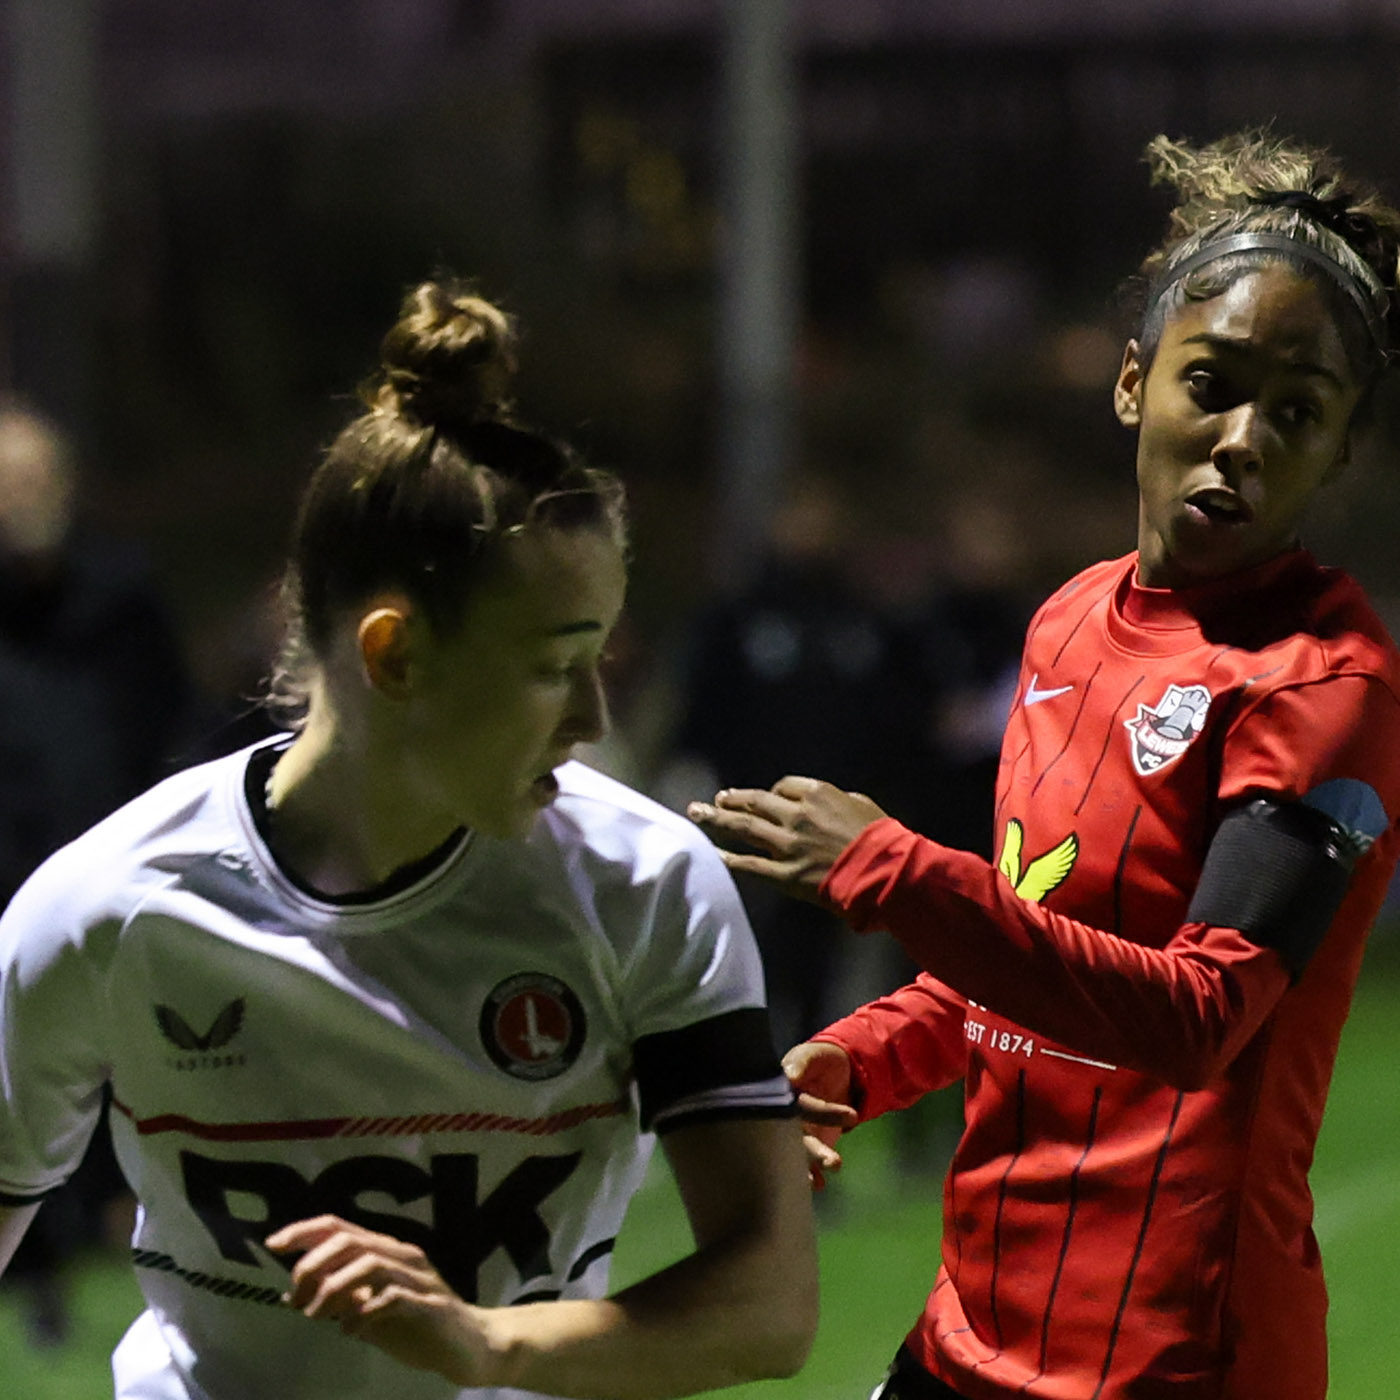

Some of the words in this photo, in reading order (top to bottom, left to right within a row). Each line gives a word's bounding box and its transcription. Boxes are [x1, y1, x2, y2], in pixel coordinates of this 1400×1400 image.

[1141, 753, 1162, 768] FC
[967, 1020, 986, 1044] EST
[990, 1029, 1034, 1057] 1874
